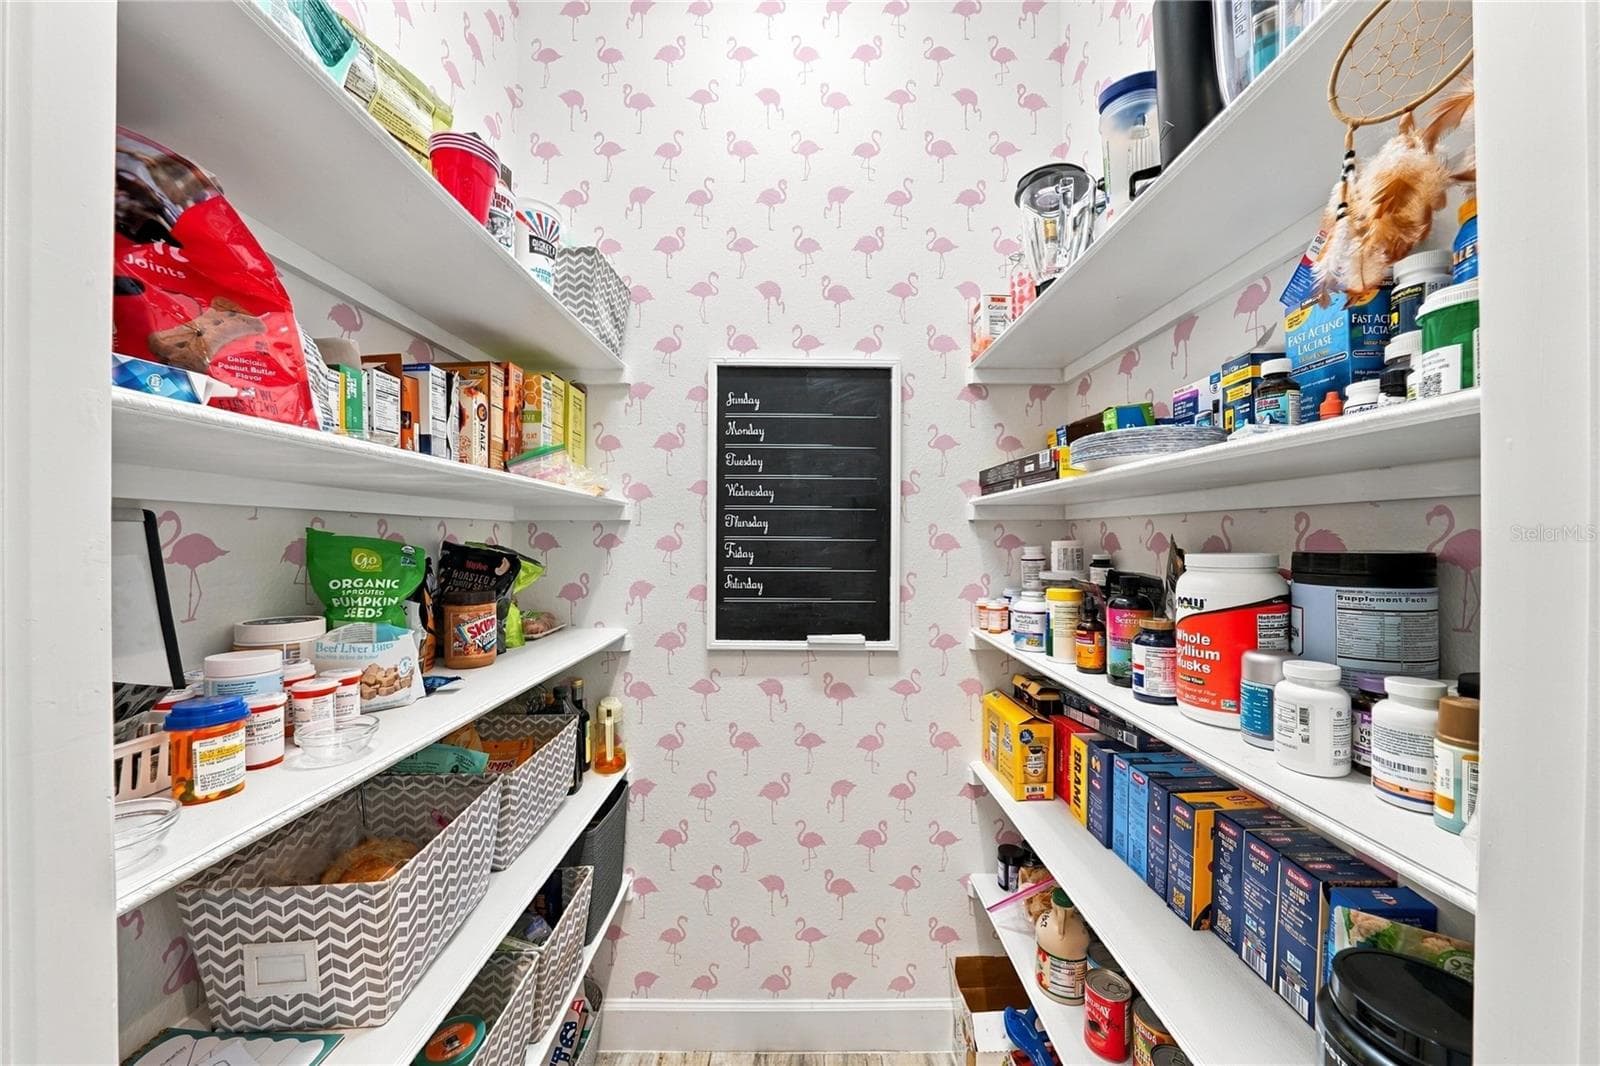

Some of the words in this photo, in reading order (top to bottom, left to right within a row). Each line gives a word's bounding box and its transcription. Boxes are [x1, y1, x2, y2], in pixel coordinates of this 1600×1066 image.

[124, 254, 186, 280] Joints
[1352, 313, 1371, 323] FAST
[1373, 313, 1391, 323] ACT
[1287, 331, 1307, 347] FAST
[1308, 316, 1345, 338] ACTING
[1363, 325, 1389, 335] LACTA
[1297, 335, 1333, 355] LACTASE
[218, 361, 248, 373] Peanut
[235, 372, 262, 382] Flavor
[726, 392, 760, 410] Sunday
[725, 421, 765, 441] Monday
[725, 453, 763, 472] Tuesday
[725, 483, 775, 503] Wednesday
[724, 514, 769, 534] Thursday
[724, 542, 754, 565] Friday
[451, 569, 490, 582] ROASTED
[328, 579, 400, 590] ORGANIC
[724, 574, 763, 596] Saturday
[331, 596, 399, 607] PUMPKIN
[1337, 595, 1404, 603] Supplement
[344, 607, 383, 618] SEEDS
[1177, 629, 1211, 646] Whole
[315, 642, 340, 653] Beef
[340, 643, 368, 654] Liver
[1073, 752, 1082, 804] BRAMI
